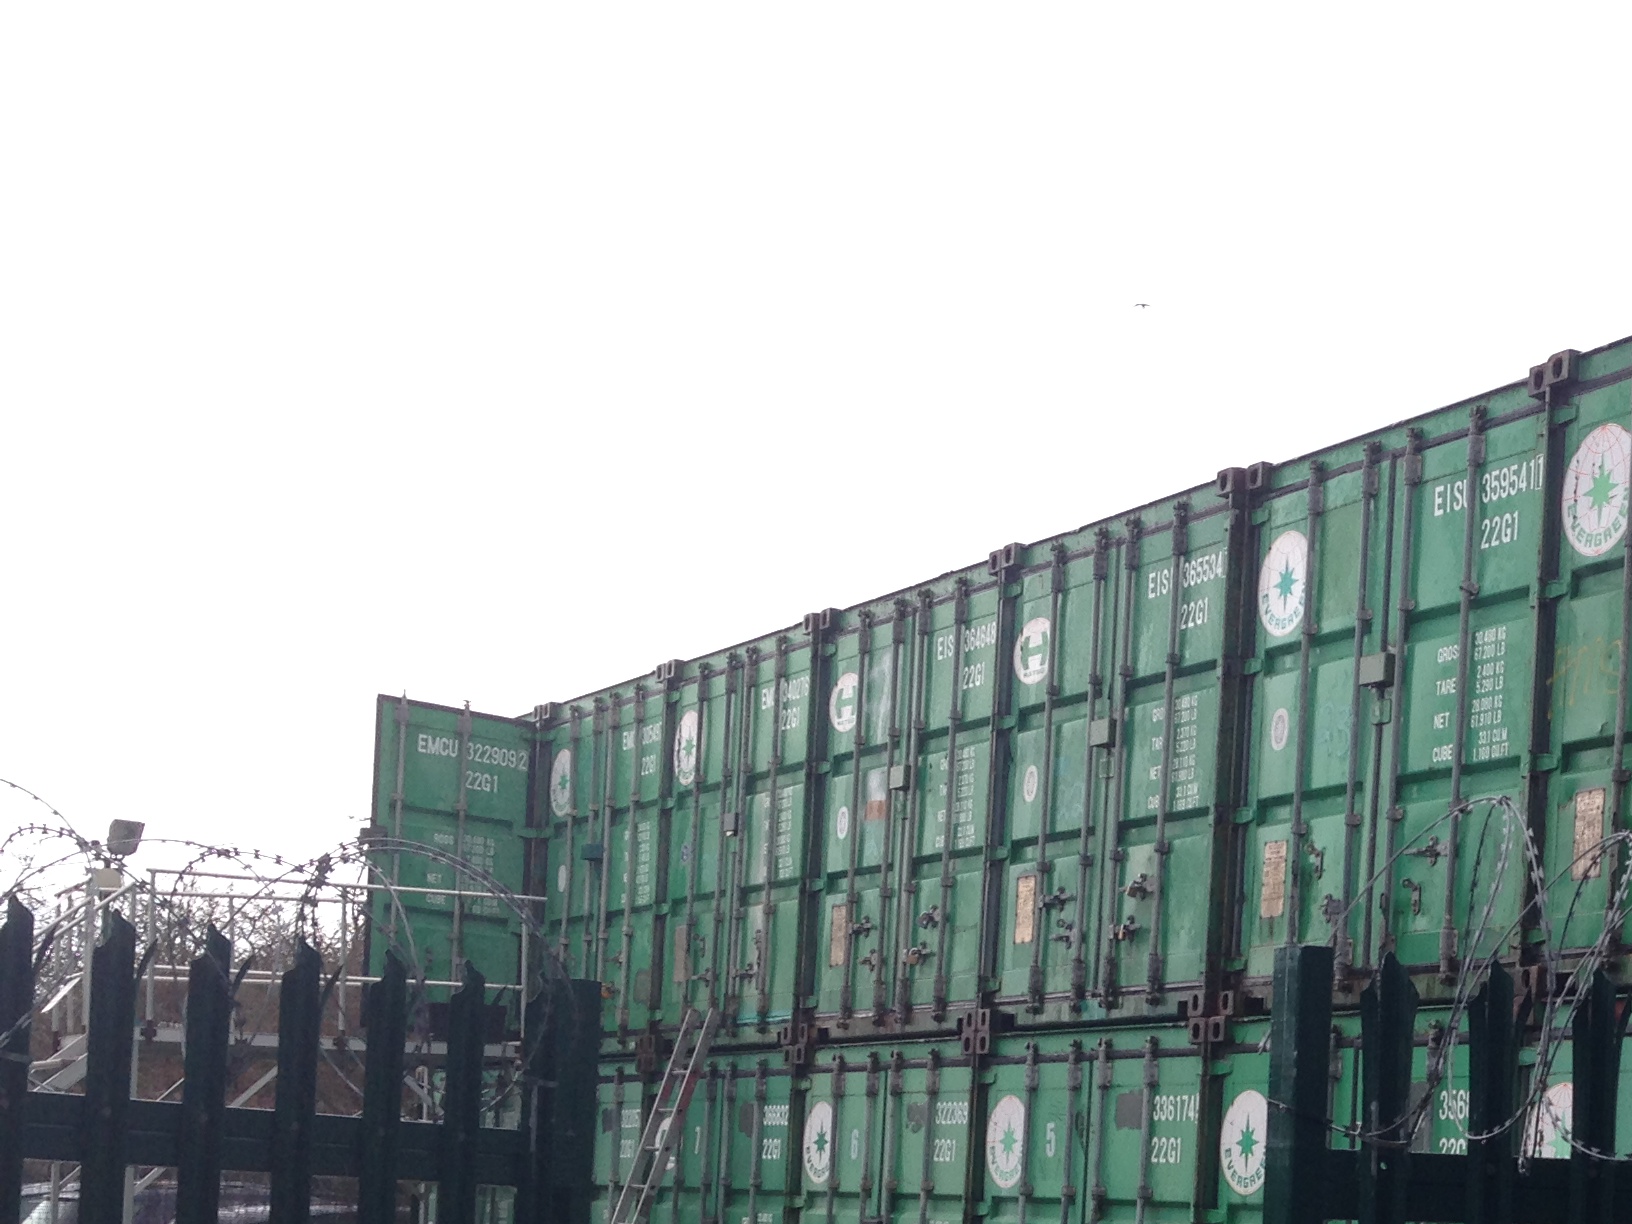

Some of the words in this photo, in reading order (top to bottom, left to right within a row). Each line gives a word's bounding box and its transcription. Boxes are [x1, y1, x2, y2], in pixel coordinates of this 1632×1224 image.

[1480, 510, 1519, 550] 22G1
[1147, 567, 1173, 600] EIS
[1182, 548, 1227, 588] 365534
[1180, 596, 1209, 630] 22G1
[937, 634, 954, 661] EIS
[1437, 645, 1460, 663] GROS
[962, 661, 985, 690] 22G1
[1433, 711, 1450, 730] NET
[417, 733, 459, 758] EMCU
[466, 742, 530, 771] 3229092
[464, 771, 499, 793] 22G1
[850, 1128, 859, 1160] 6
[933, 1138, 957, 1162] 22G1
[1045, 1122, 1056, 1158] 5
[1151, 1136, 1182, 1164] 22G1
